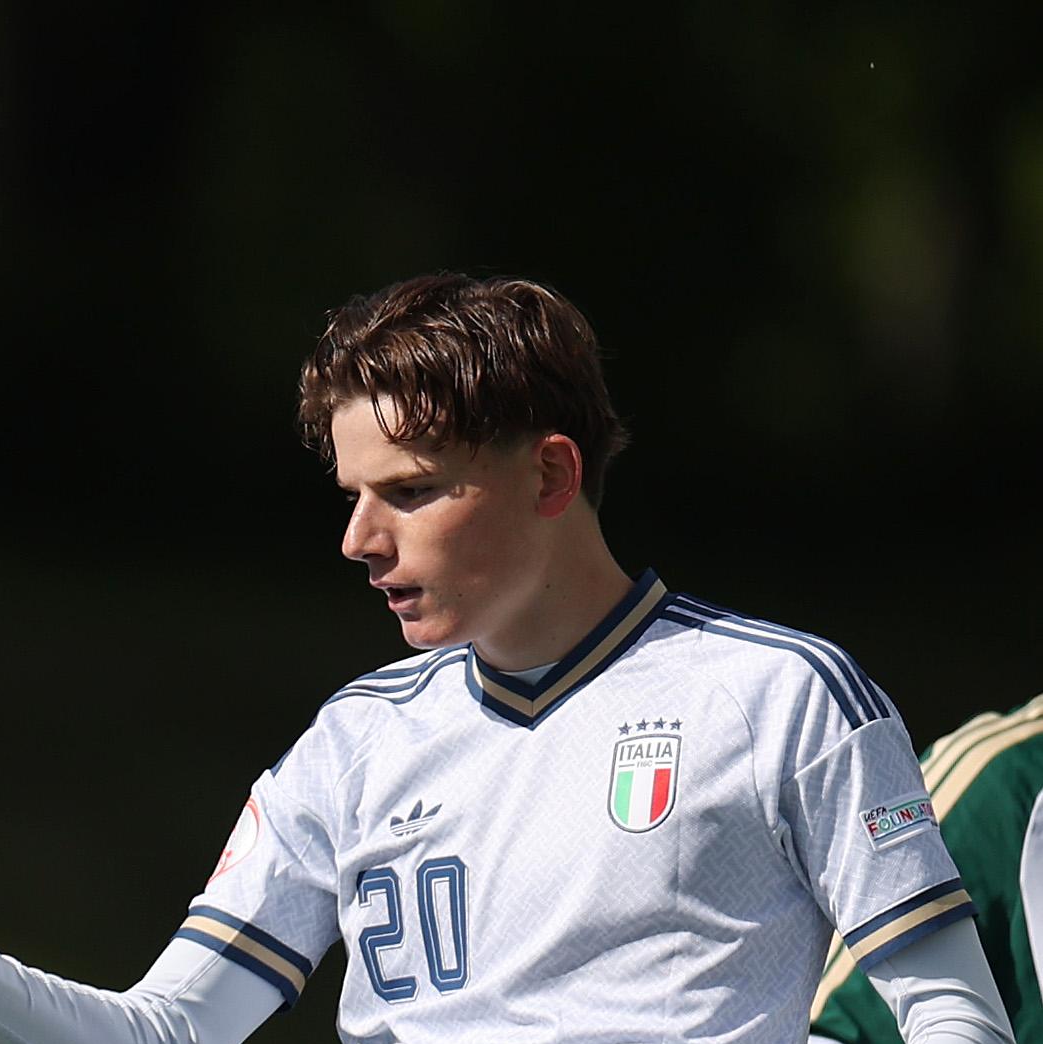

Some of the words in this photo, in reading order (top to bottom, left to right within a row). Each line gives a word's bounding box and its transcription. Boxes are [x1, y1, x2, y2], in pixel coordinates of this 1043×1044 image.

[619, 741, 673, 761] ITALIA
[864, 805, 887, 822] UEFA
[356, 855, 471, 1004] 20
